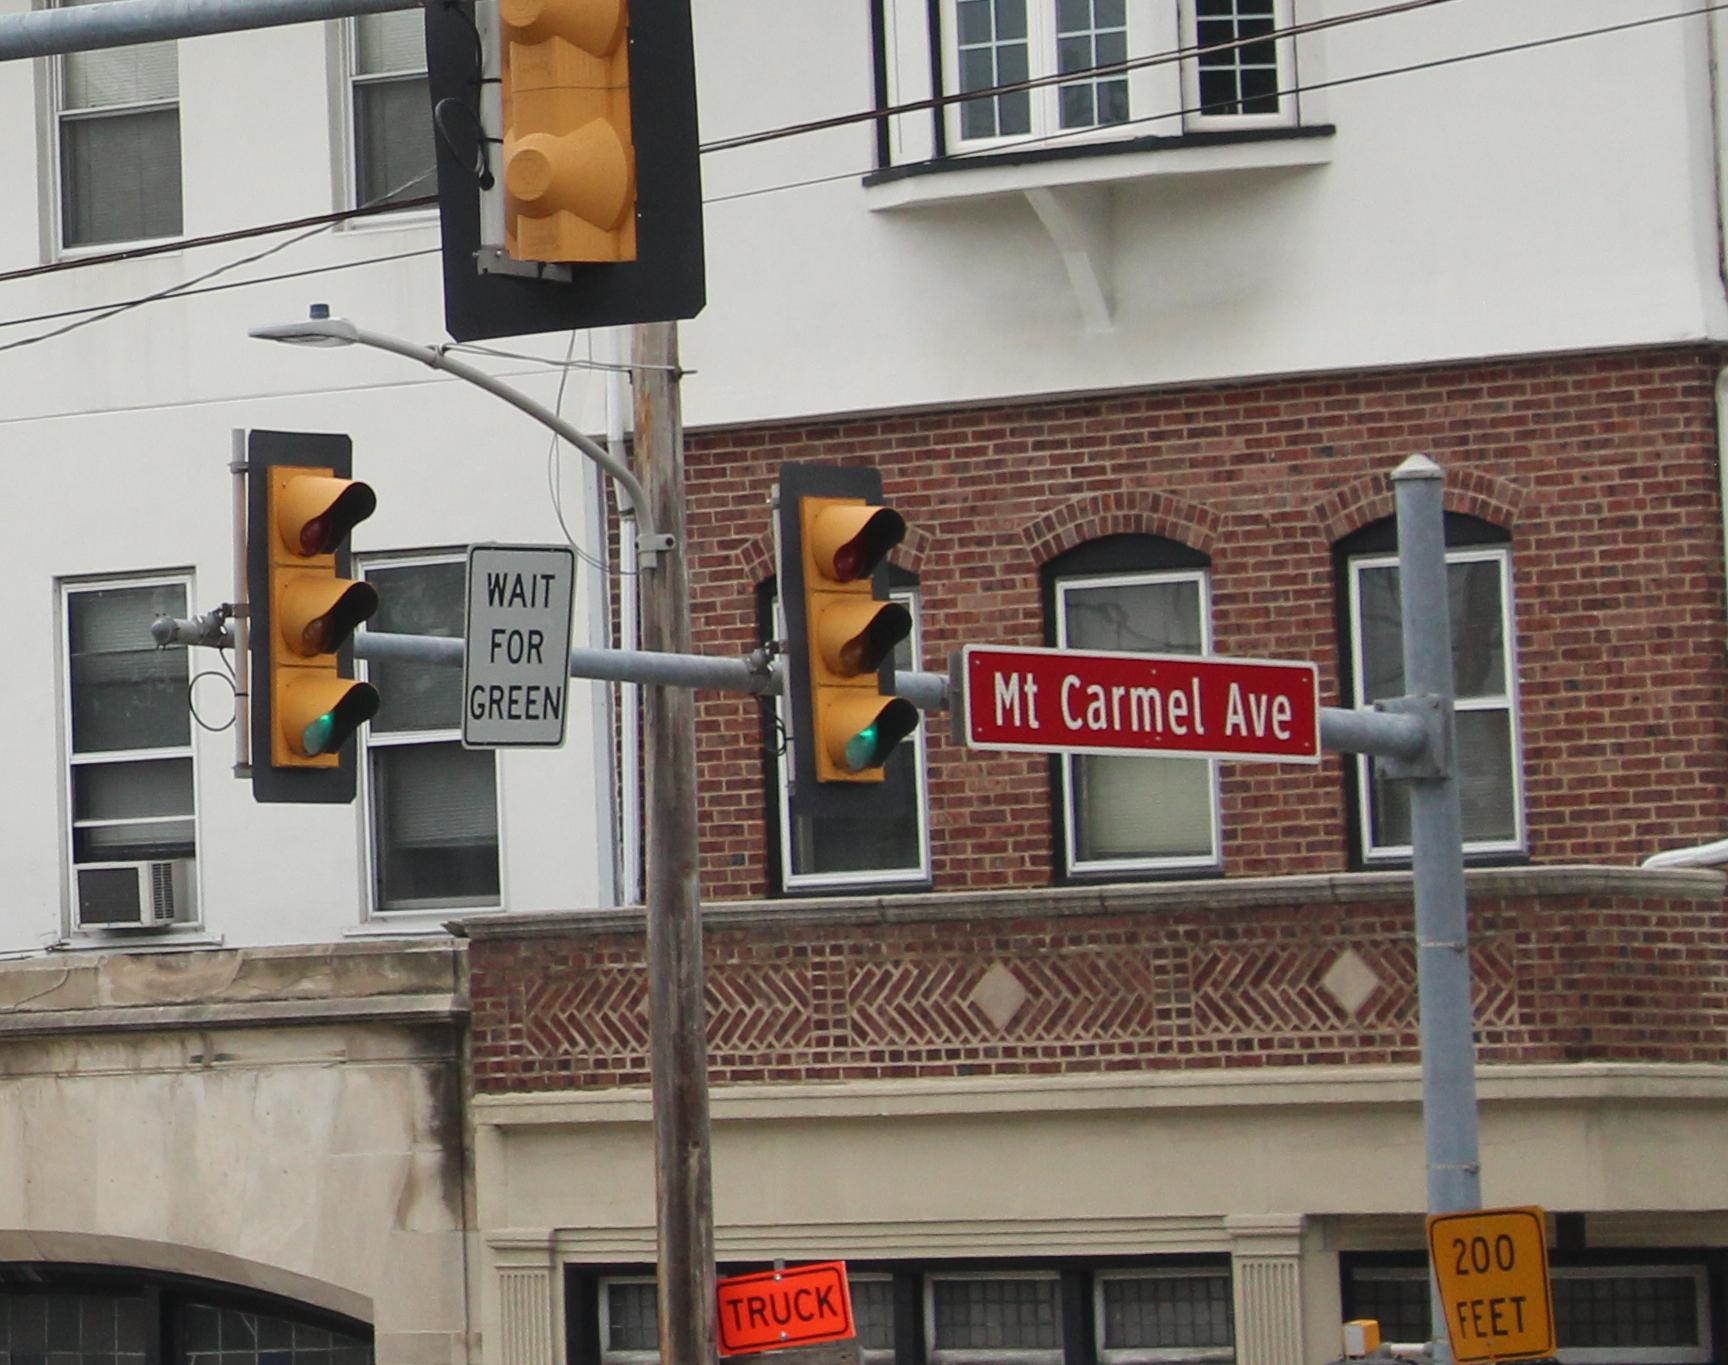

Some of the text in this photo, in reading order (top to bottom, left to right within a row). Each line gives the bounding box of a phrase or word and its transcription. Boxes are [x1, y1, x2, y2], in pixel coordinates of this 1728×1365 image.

[488, 573, 556, 608] WAIT
[490, 629, 544, 664] FOR
[470, 685, 561, 720] GREEN
[994, 672, 1292, 740] Mt Carmel Ave
[1453, 1234, 1515, 1276] 200
[726, 1285, 839, 1331] TRUCK
[1456, 1295, 1527, 1339] FEET
